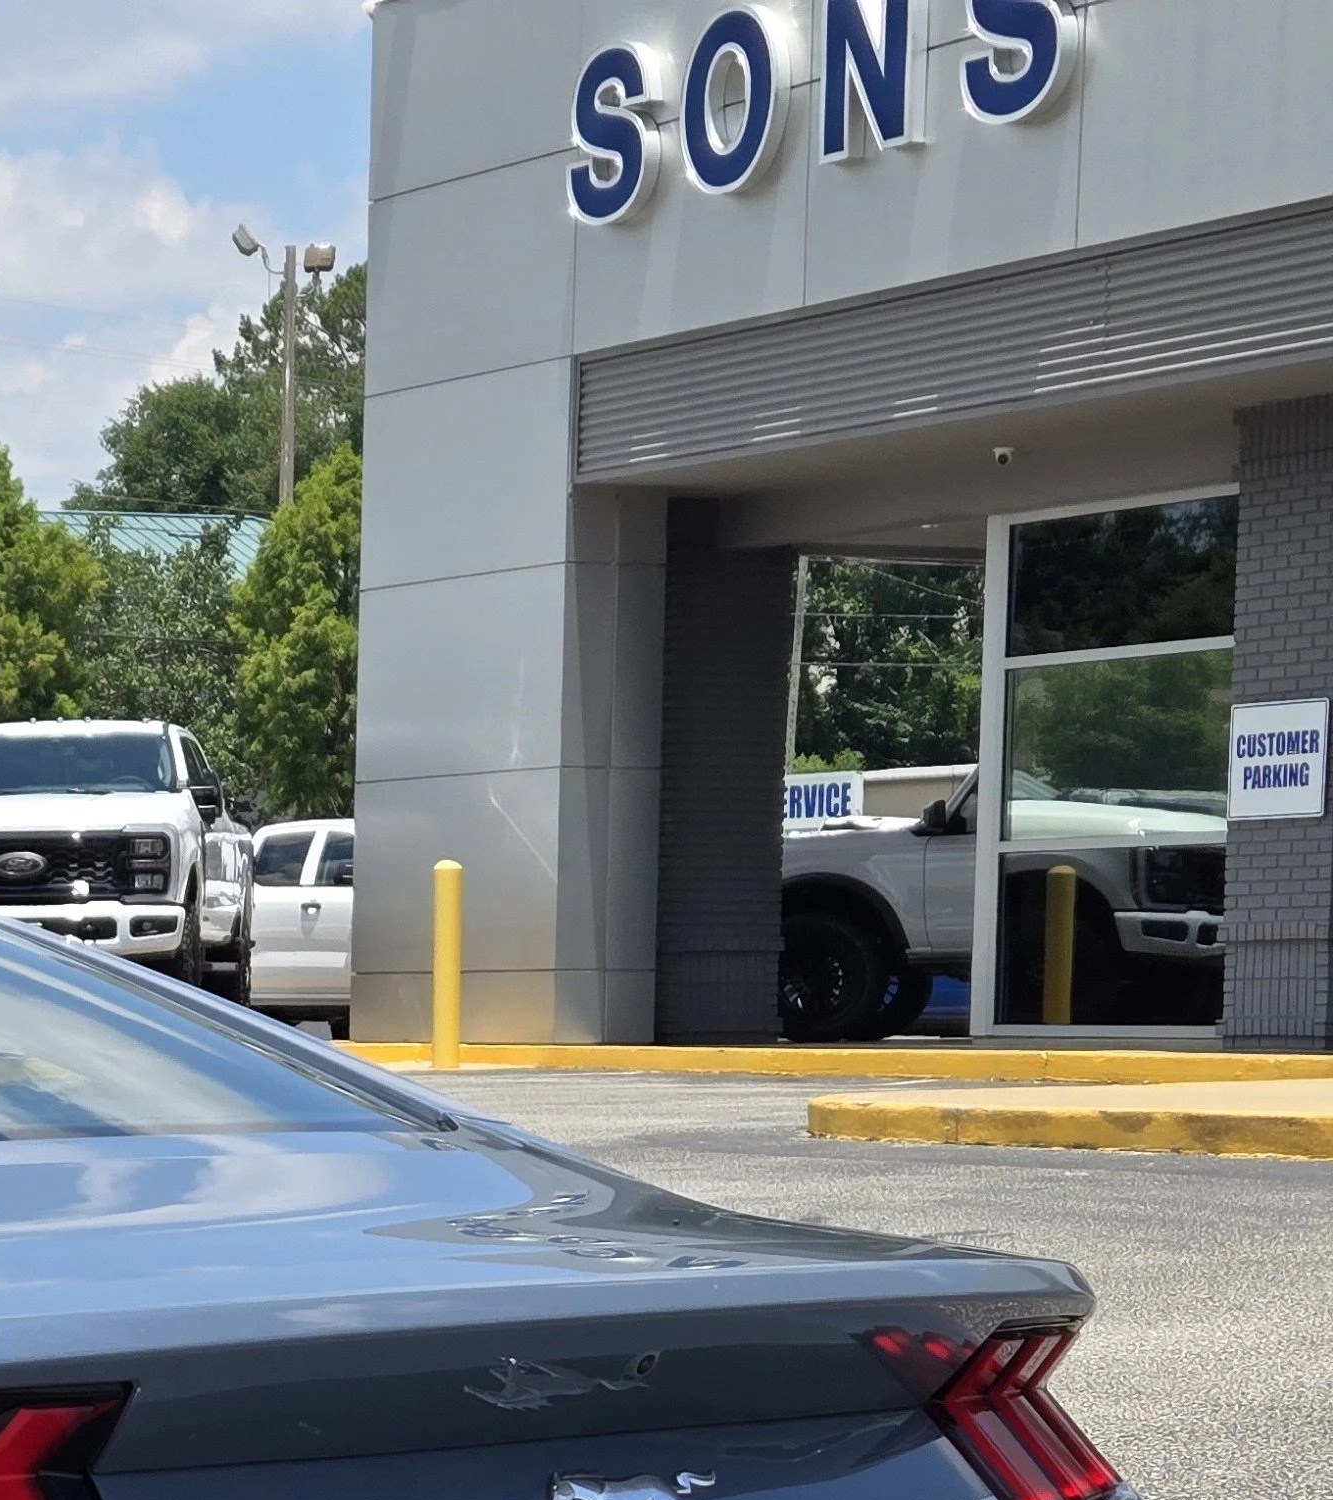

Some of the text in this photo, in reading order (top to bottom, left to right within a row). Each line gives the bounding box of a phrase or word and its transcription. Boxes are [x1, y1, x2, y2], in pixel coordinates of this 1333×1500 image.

[566, 0, 1071, 225] SONS
[1236, 729, 1320, 758] CUSTOMER
[1243, 762, 1310, 790] PARKING
